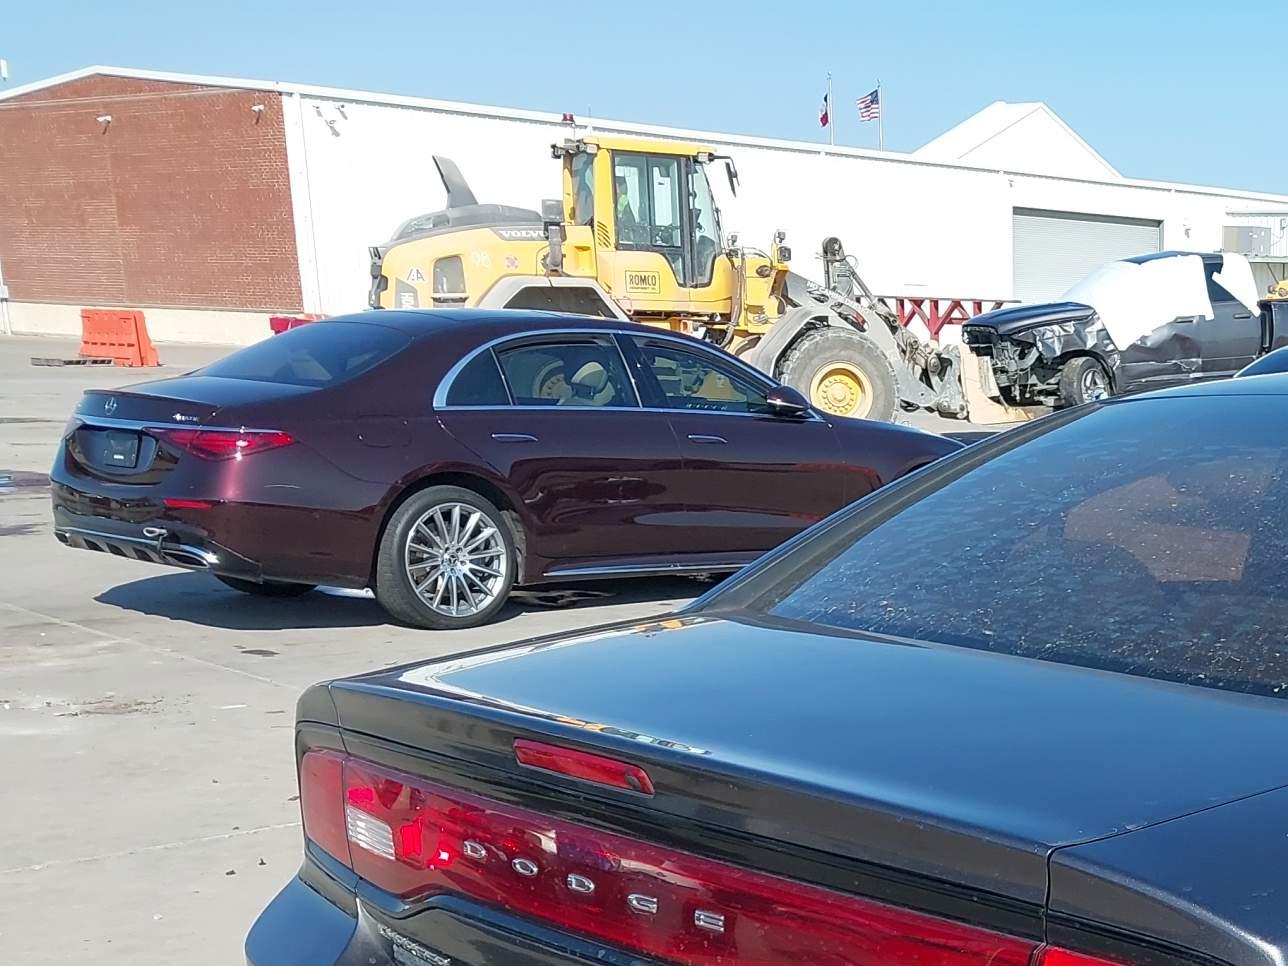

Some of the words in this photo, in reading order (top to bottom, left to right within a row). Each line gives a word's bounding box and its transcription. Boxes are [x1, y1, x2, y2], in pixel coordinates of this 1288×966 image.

[498, 229, 549, 238] VOLVO
[629, 274, 657, 286] ROMCO
[463, 839, 726, 933] DODGE
